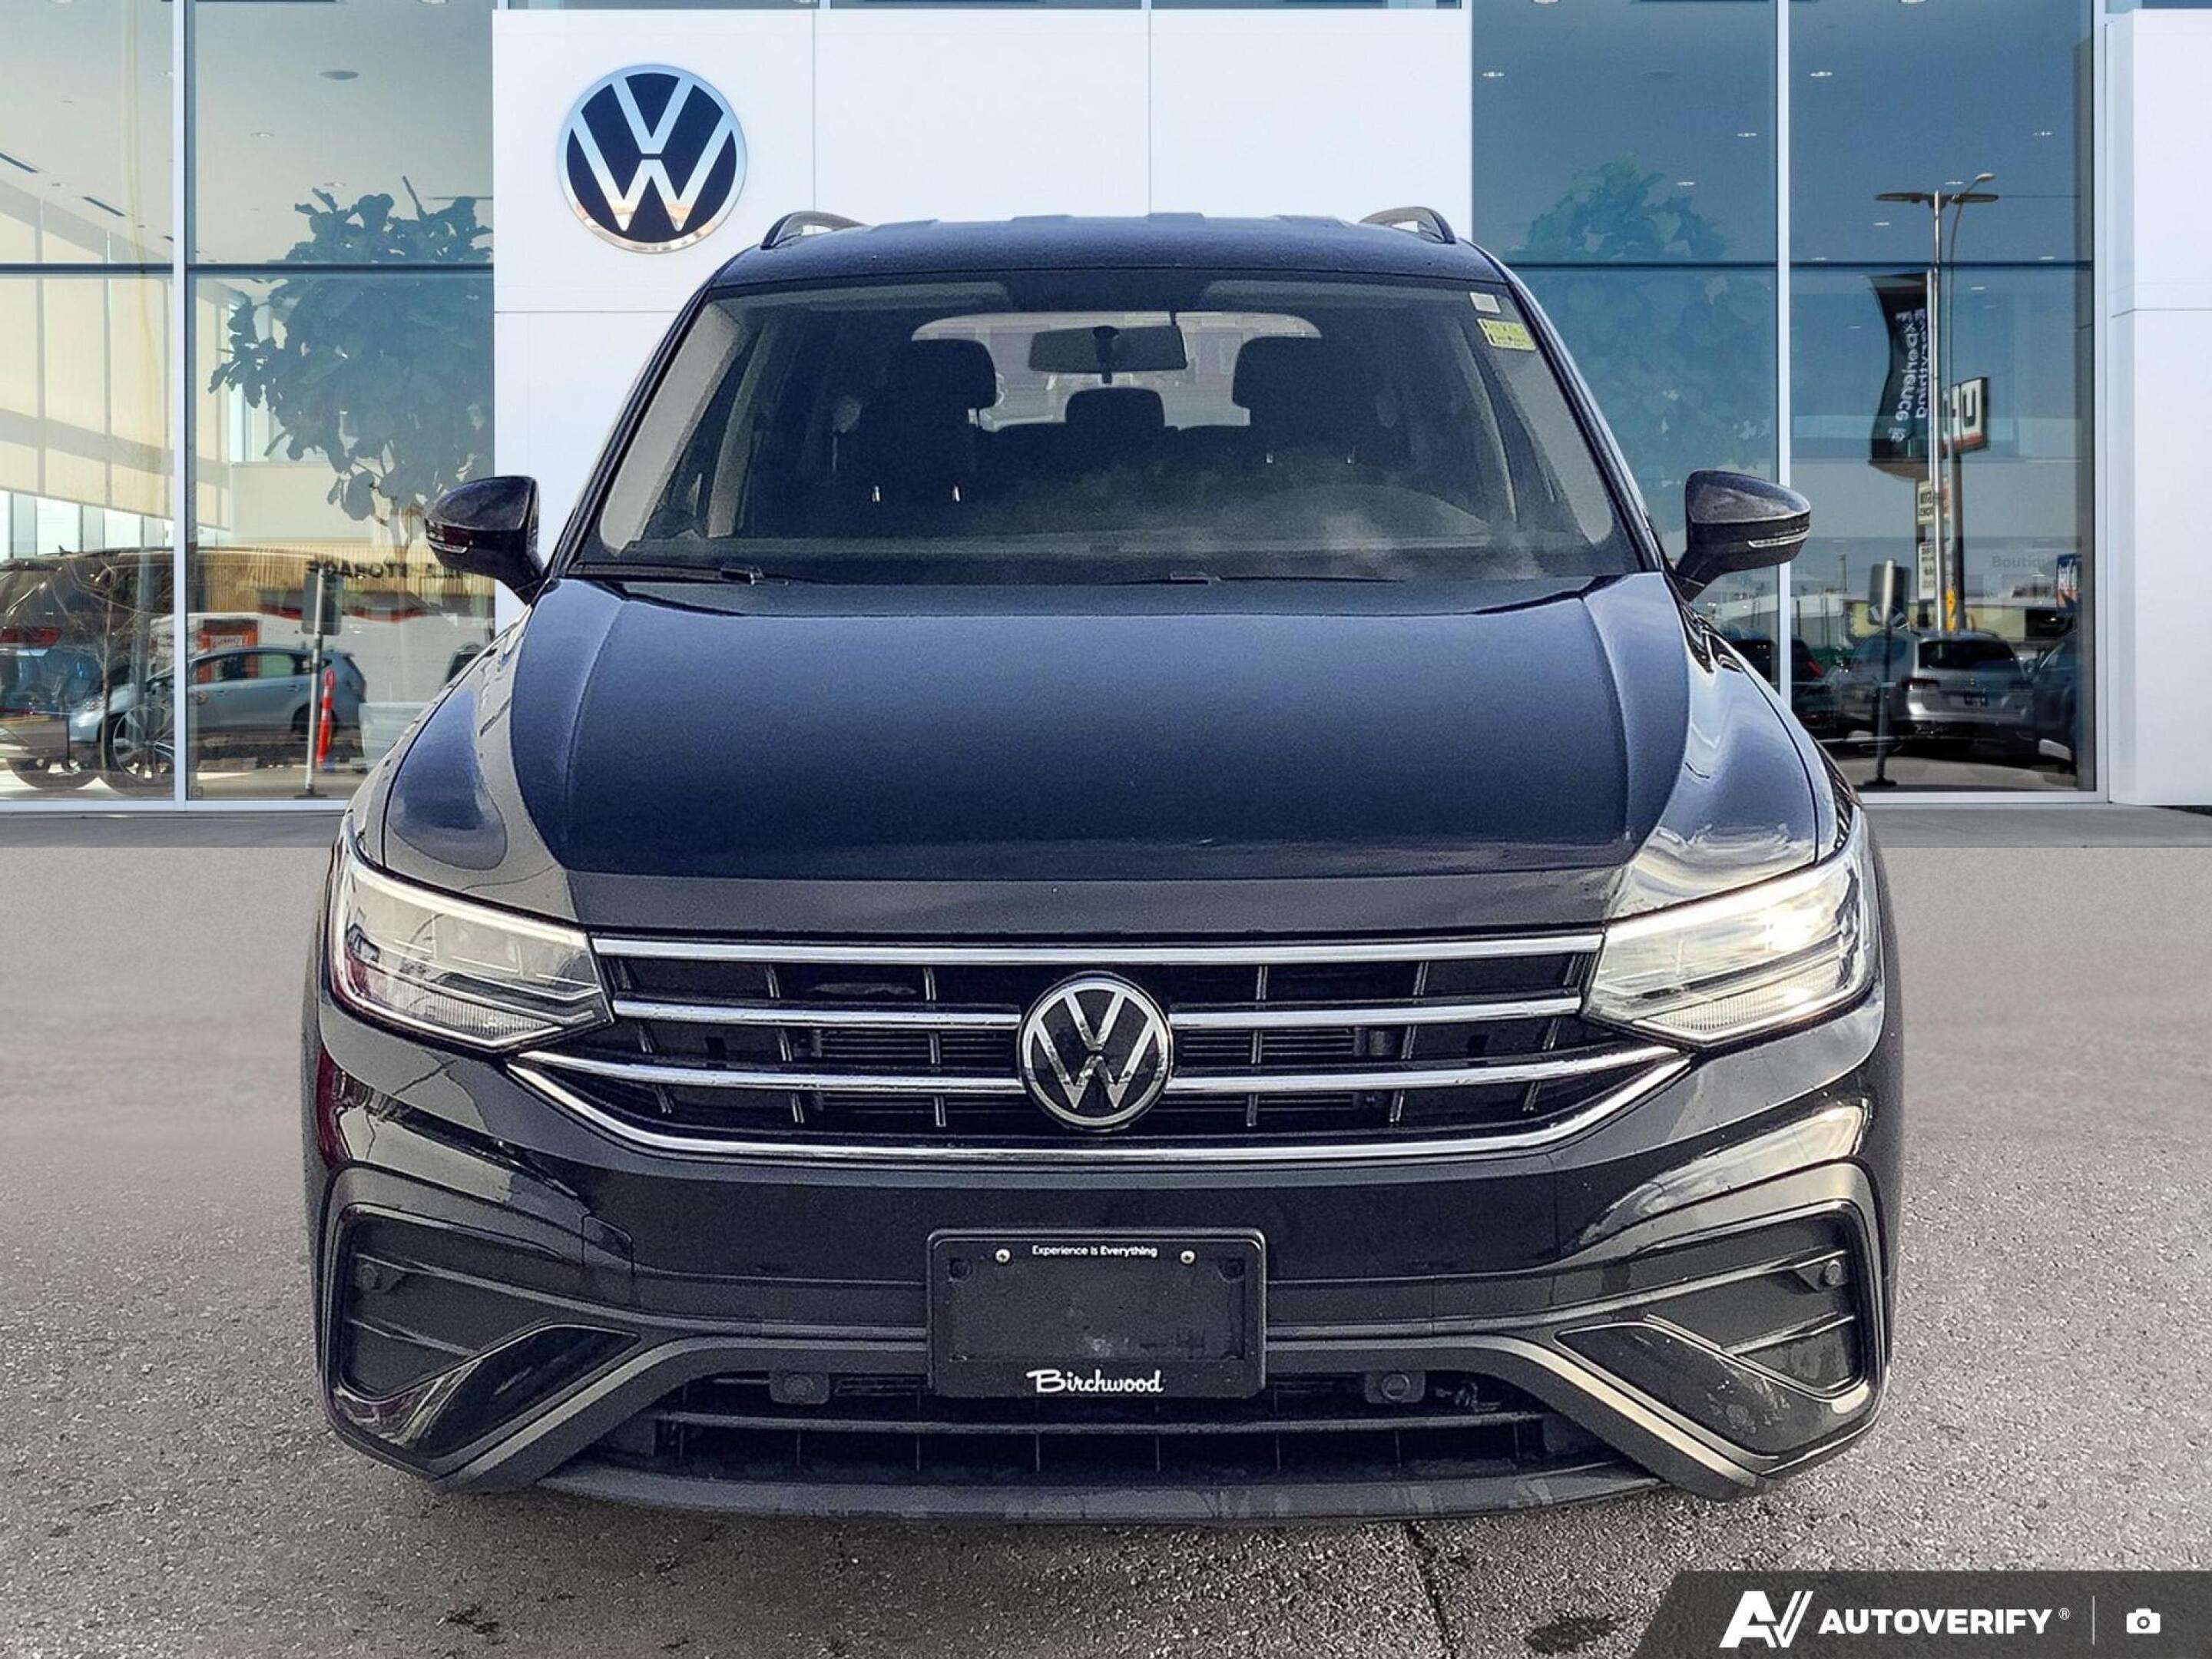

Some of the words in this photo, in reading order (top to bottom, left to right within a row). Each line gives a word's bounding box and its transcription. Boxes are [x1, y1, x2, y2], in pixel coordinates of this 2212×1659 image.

[1031, 1244, 1088, 1257] Experience
[1100, 1245, 1158, 1258] Everything
[1025, 1369, 1164, 1394] Birchwood
